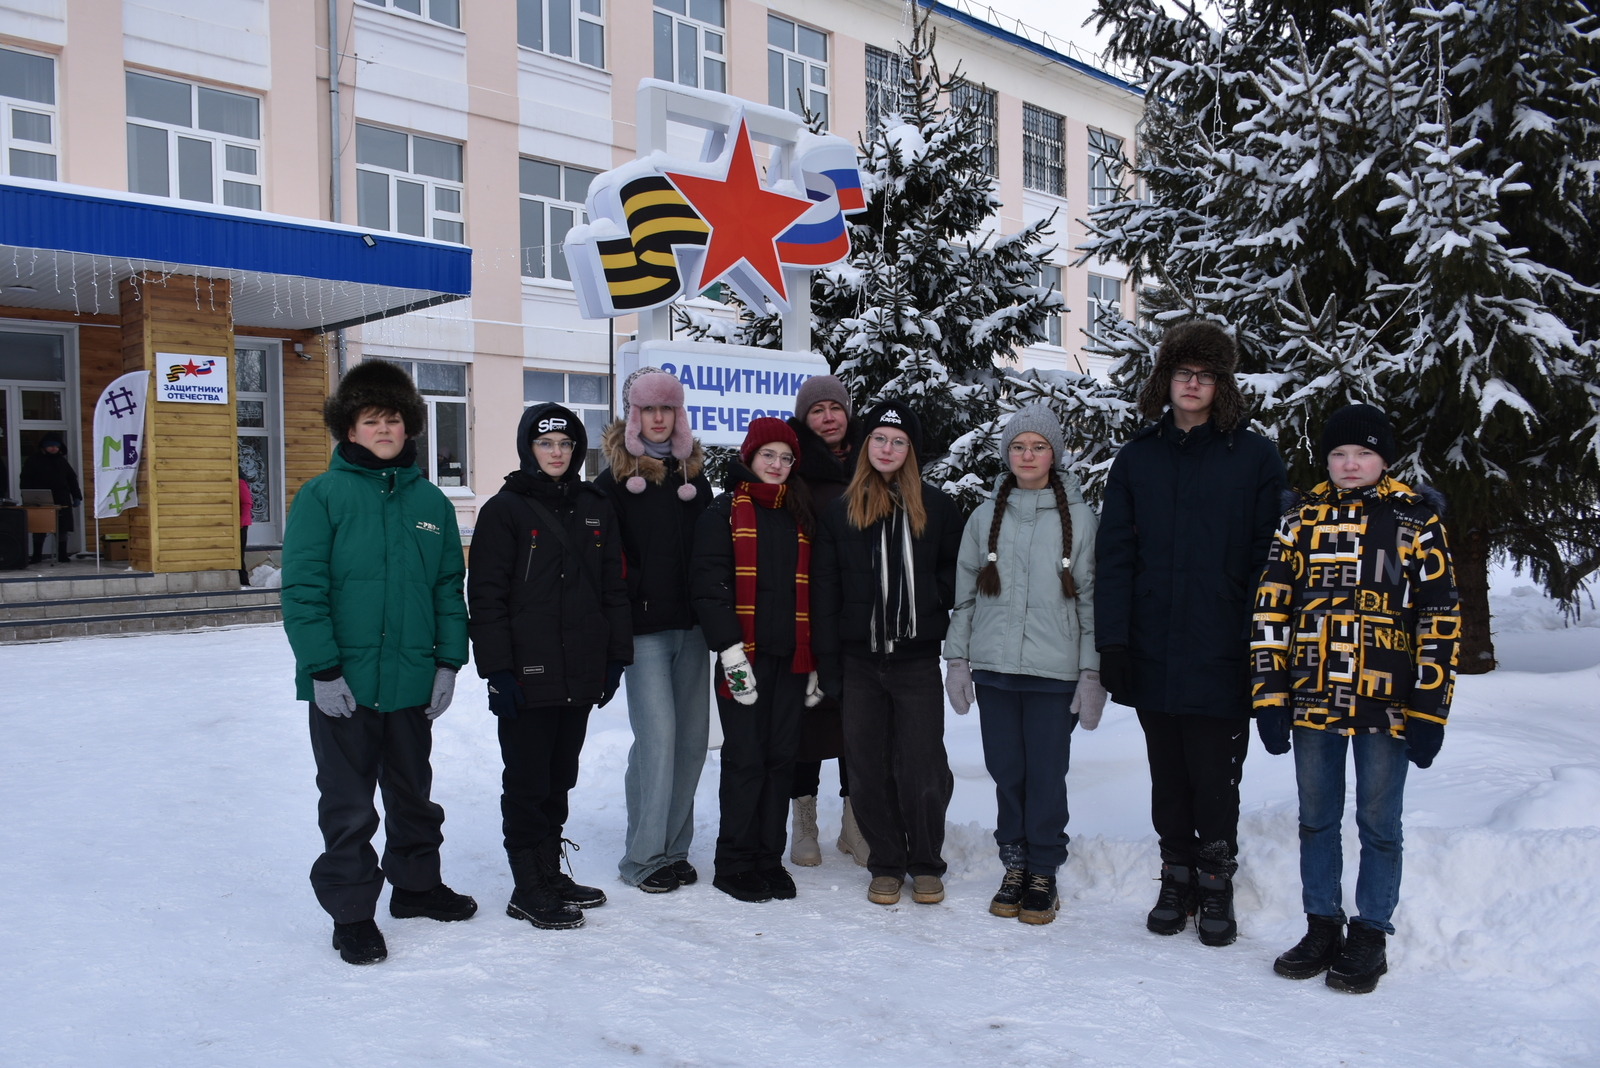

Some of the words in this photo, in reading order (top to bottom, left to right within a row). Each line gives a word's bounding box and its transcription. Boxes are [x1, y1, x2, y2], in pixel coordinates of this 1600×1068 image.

[661, 362, 813, 397] АЩИТНИК
[163, 384, 224, 393] ЗАЩИТНИКИ
[167, 392, 220, 401] ОТЕЧЕСТВА
